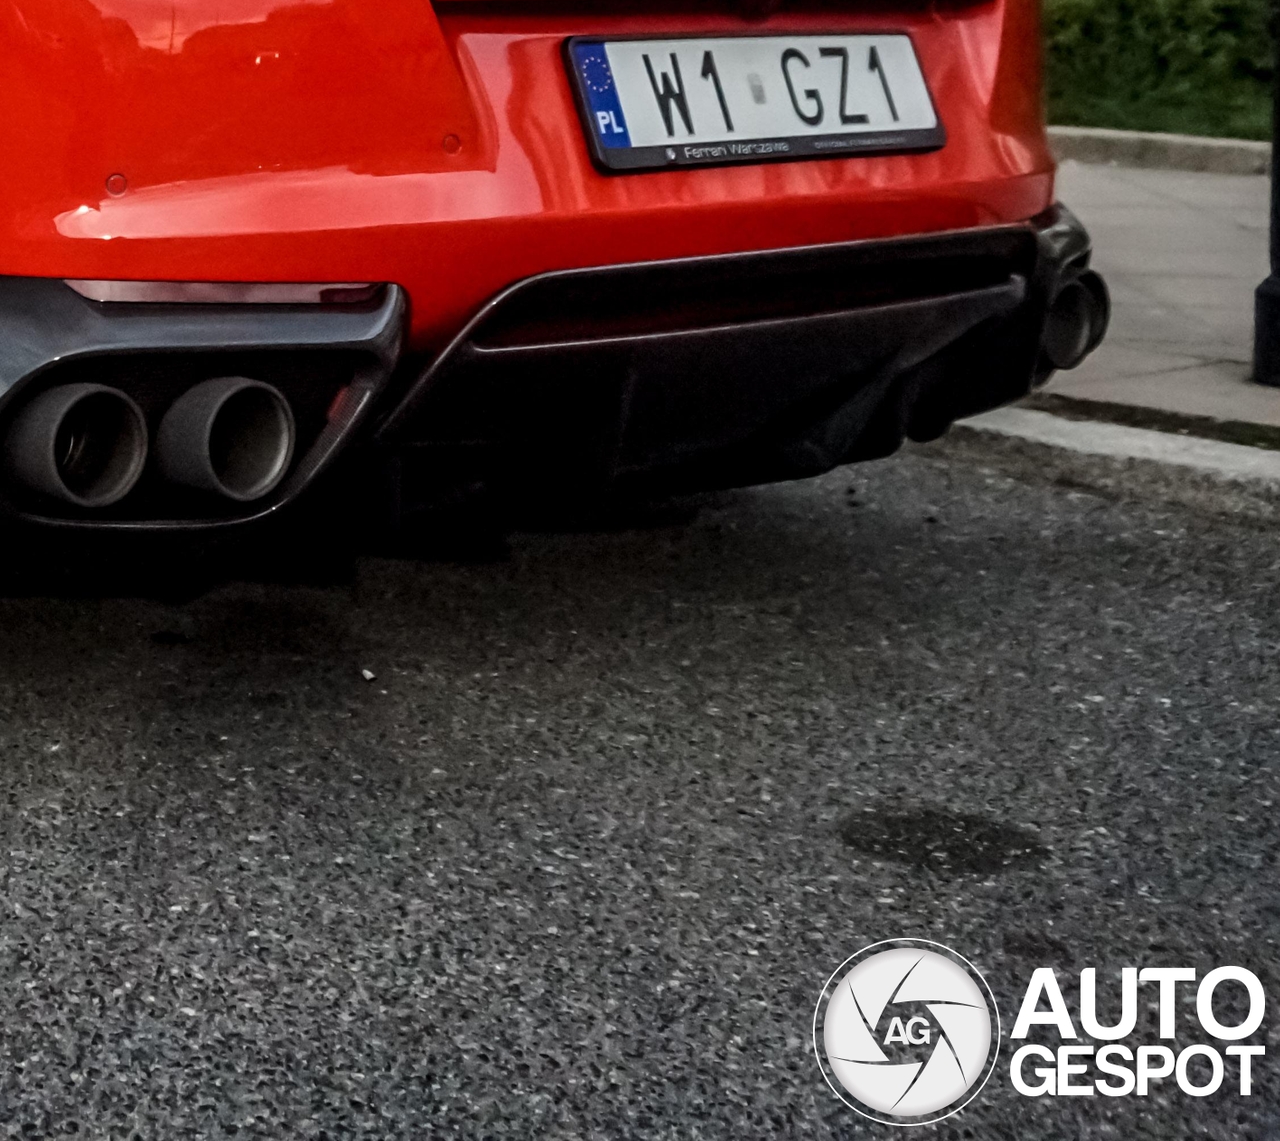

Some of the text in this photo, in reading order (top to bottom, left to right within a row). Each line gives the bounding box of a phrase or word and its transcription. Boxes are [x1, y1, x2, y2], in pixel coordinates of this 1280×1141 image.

[641, 45, 900, 137] W1 GZ1
[596, 110, 623, 135] PL
